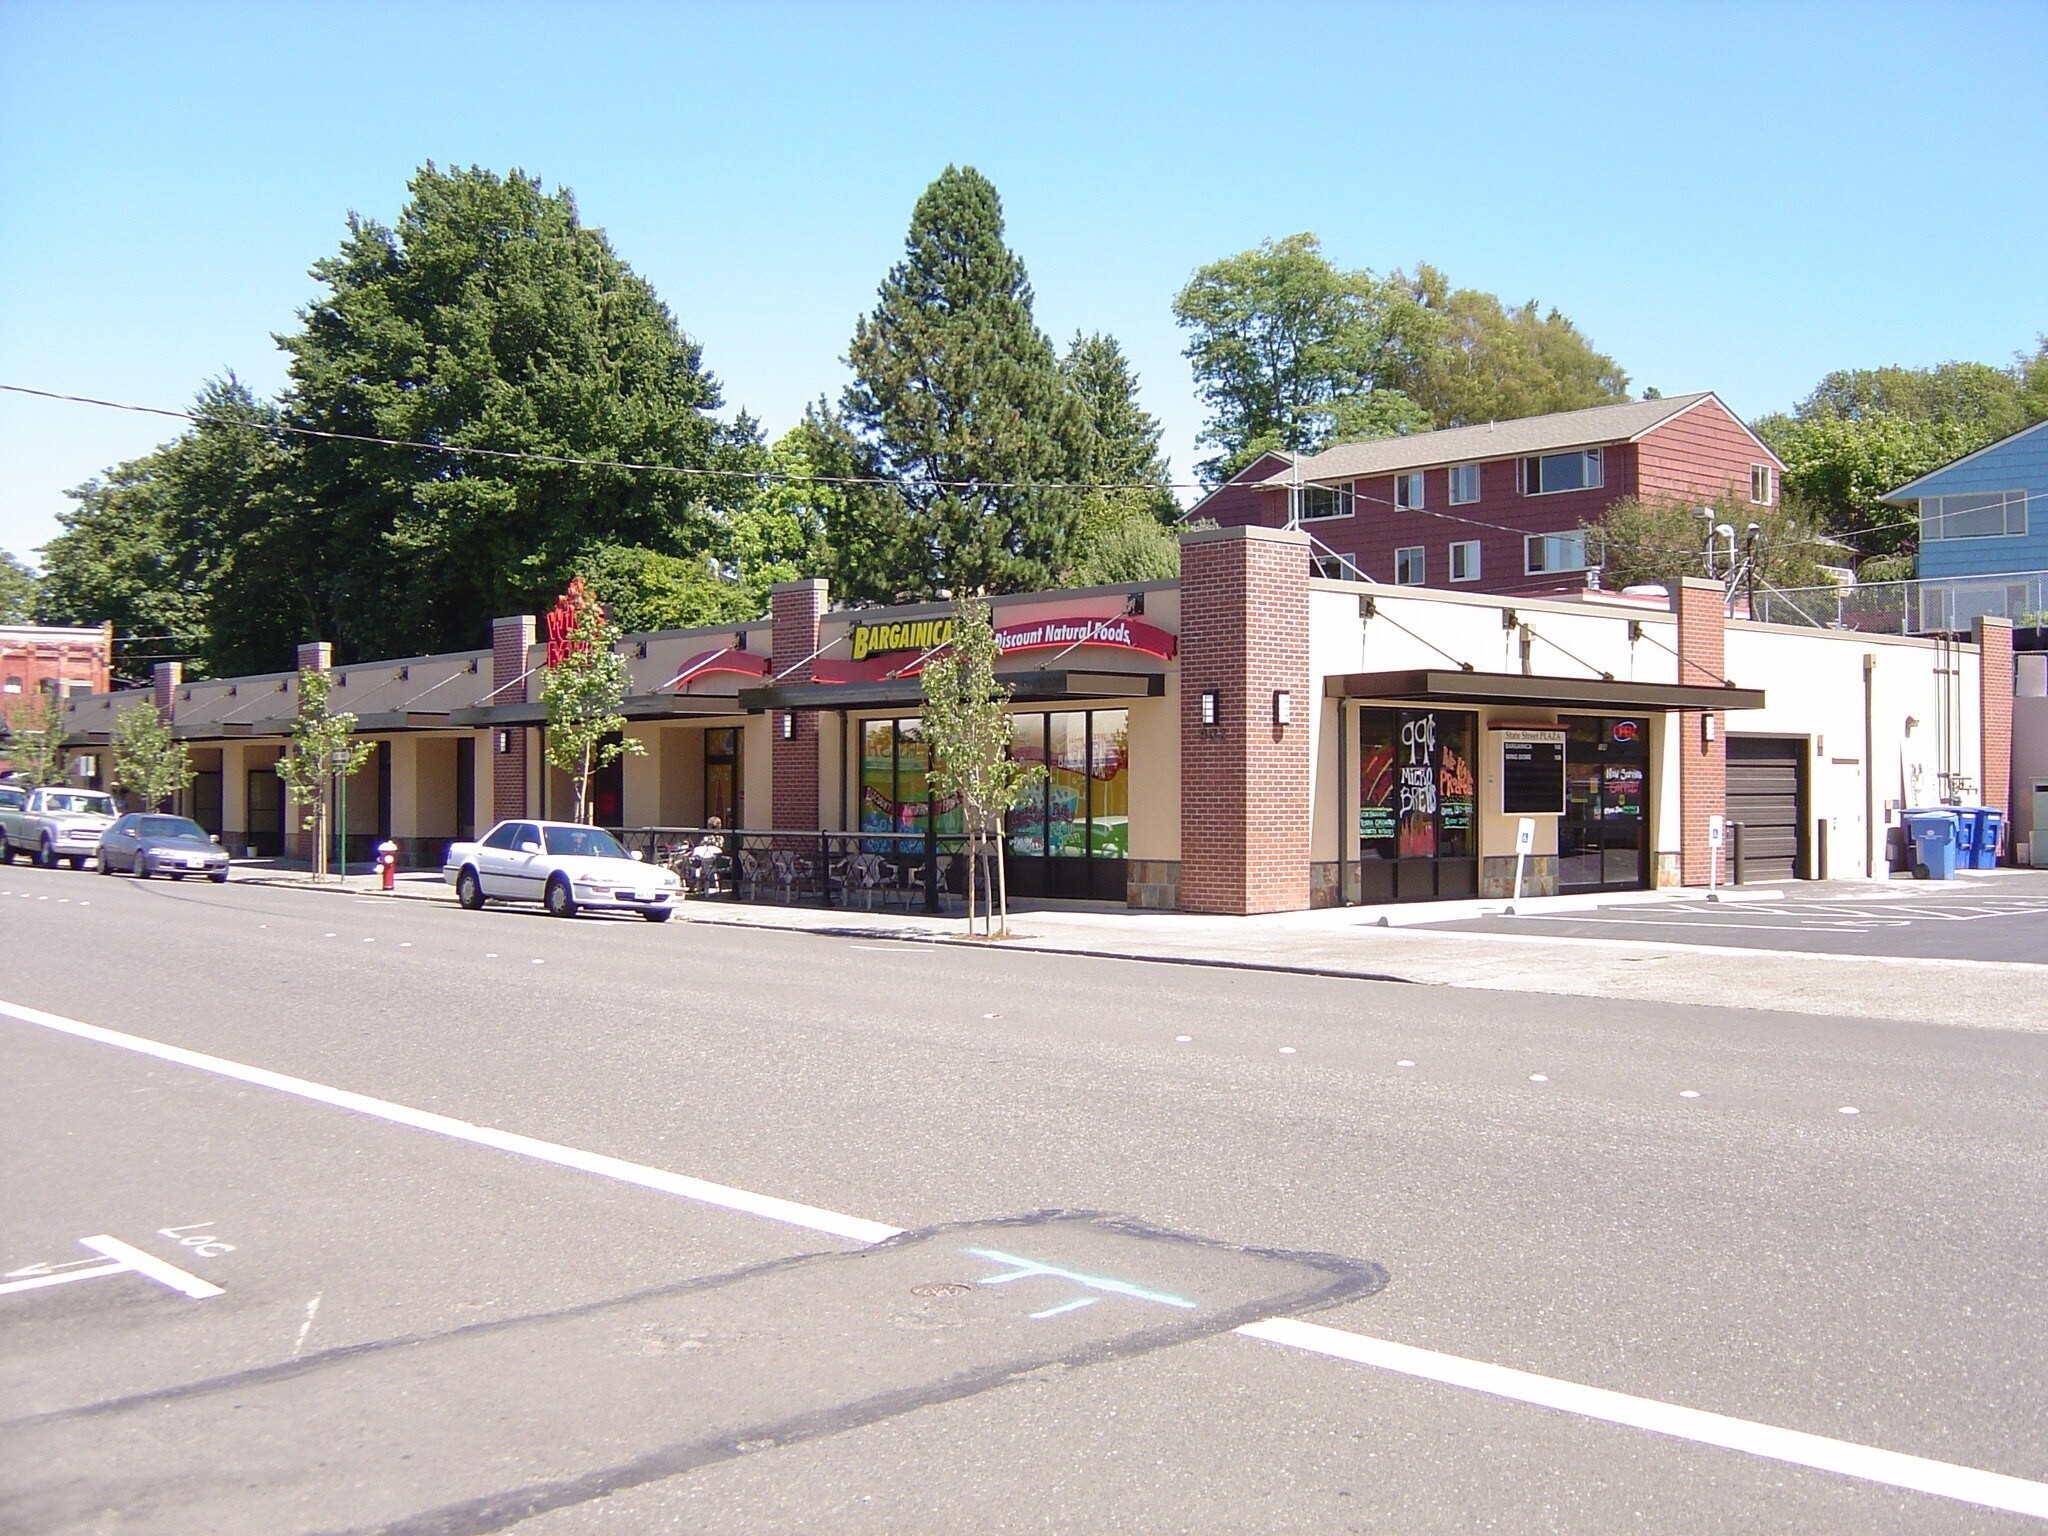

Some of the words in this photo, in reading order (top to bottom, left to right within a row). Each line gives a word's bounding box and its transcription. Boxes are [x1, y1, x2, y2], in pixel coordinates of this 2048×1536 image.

[853, 620, 952, 660] BARGAINICA
[994, 626, 1042, 649] Discount
[1045, 620, 1092, 642] Natural
[1093, 621, 1131, 646] Foods
[1505, 731, 1520, 740] State
[1521, 731, 1539, 740] Street
[1539, 732, 1561, 741] PLAZA
